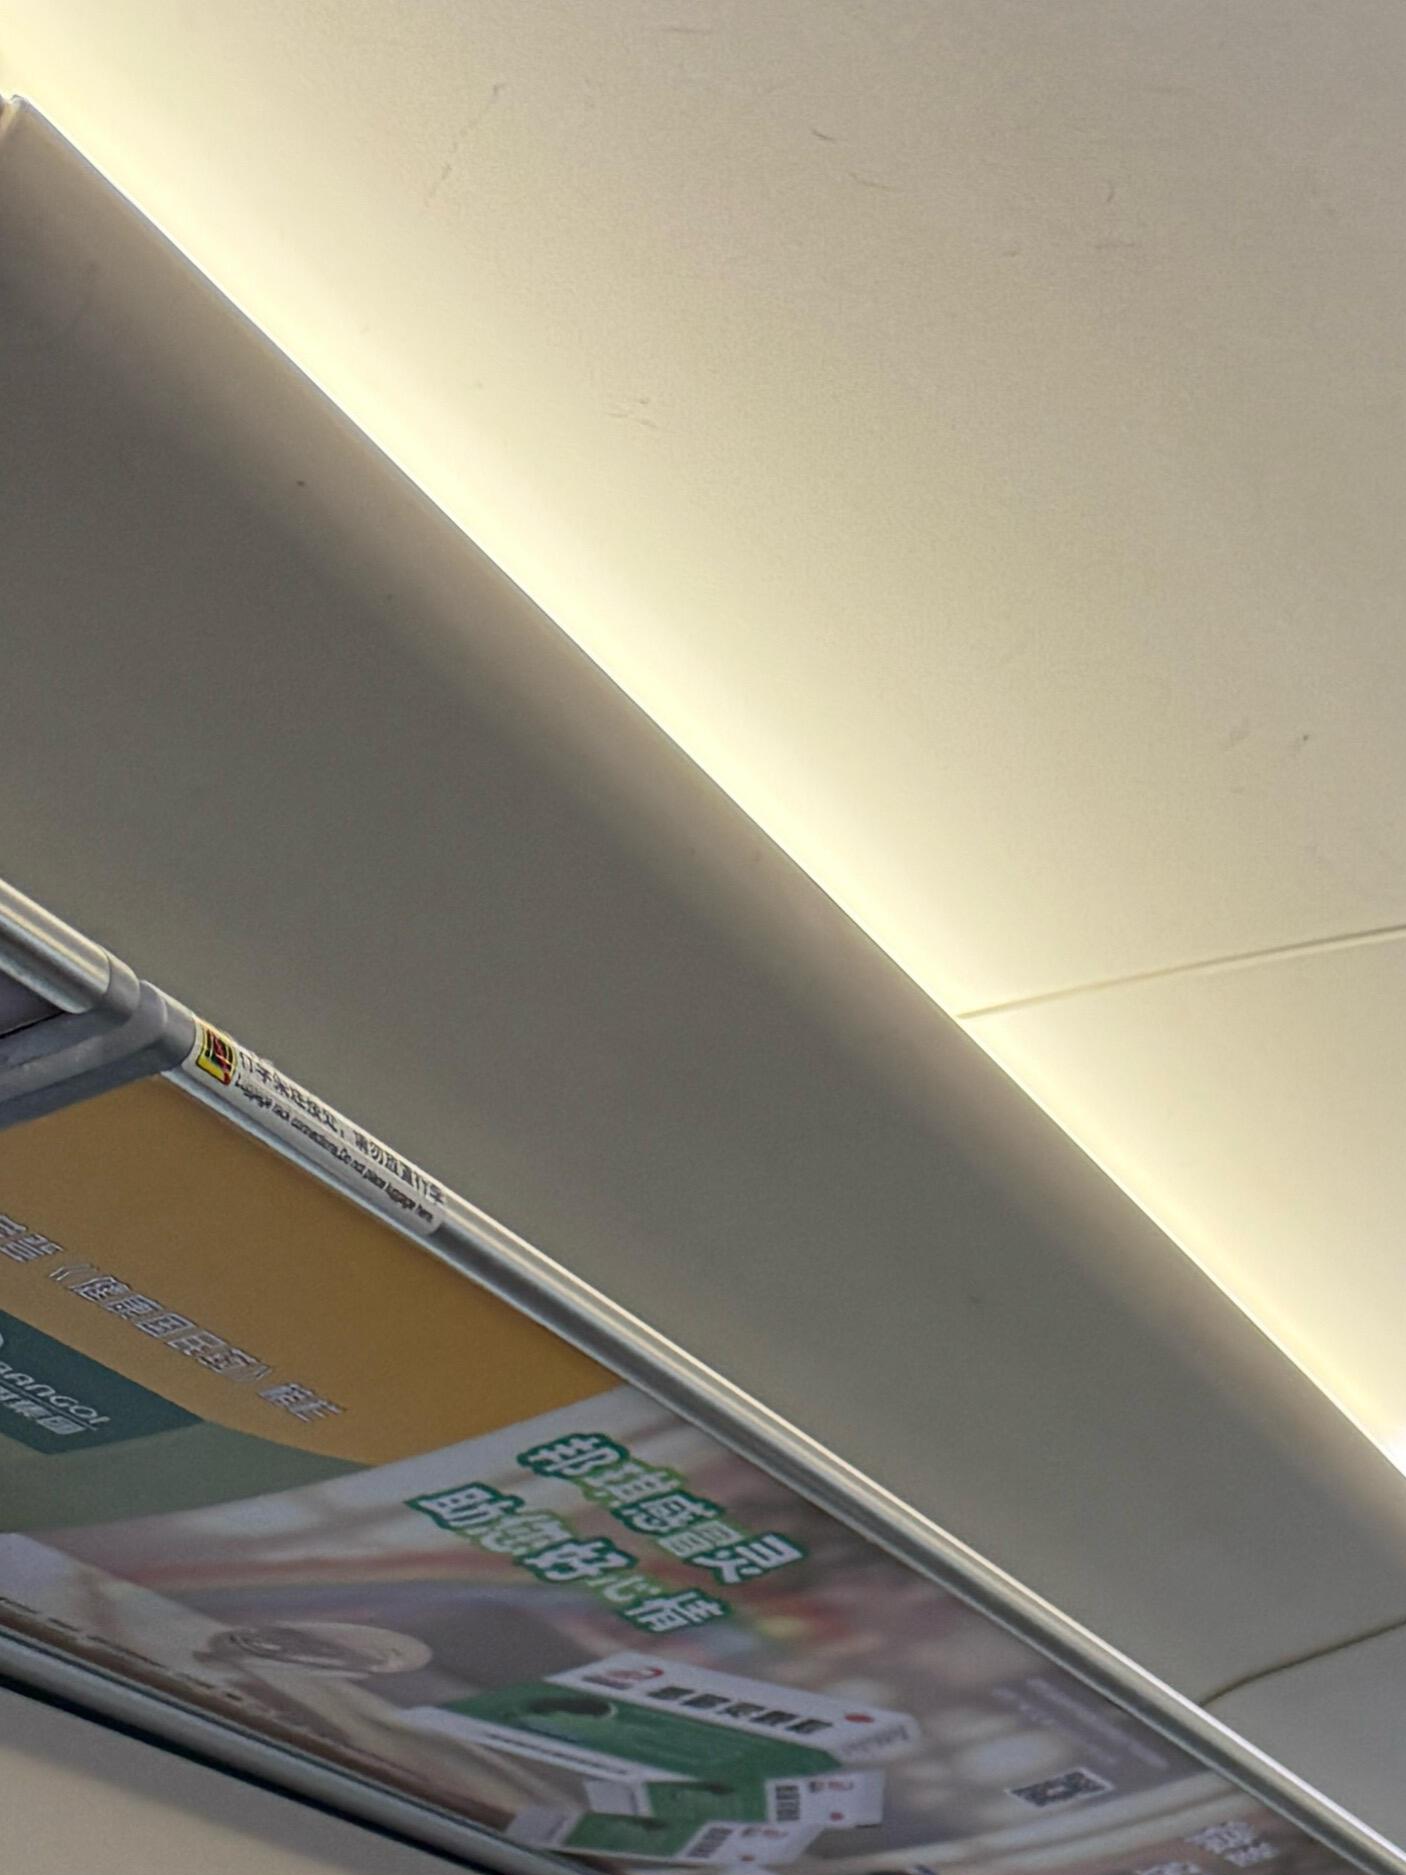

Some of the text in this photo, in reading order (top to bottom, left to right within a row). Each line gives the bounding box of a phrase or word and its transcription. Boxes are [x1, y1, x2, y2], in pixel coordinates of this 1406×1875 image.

[416, 1487, 724, 1632] 助您好心情
[526, 1437, 804, 1583] 邦琪感冒灵
